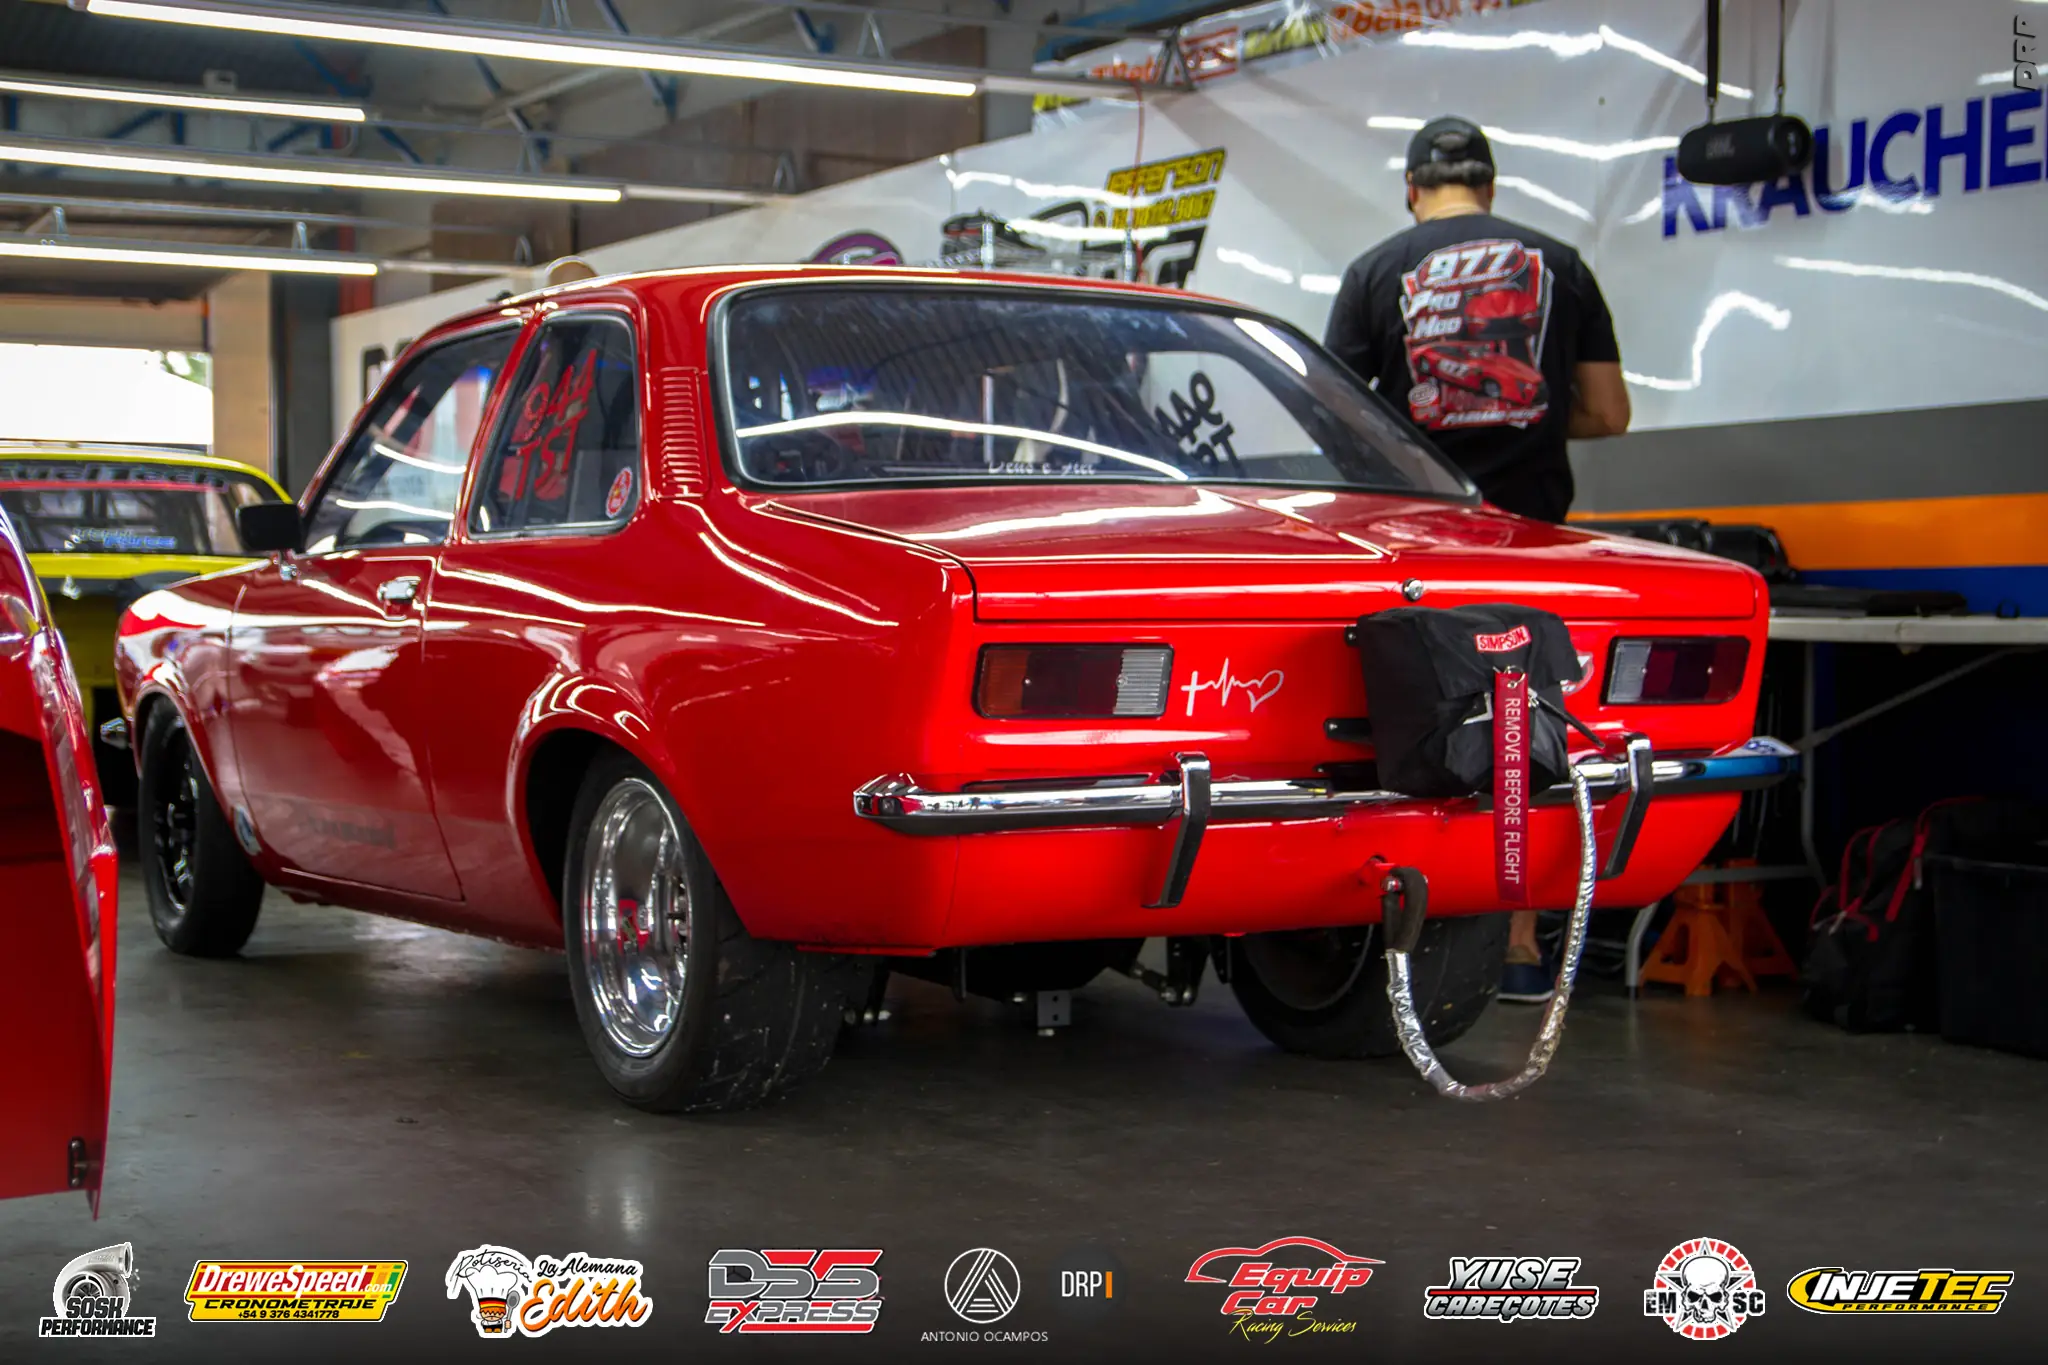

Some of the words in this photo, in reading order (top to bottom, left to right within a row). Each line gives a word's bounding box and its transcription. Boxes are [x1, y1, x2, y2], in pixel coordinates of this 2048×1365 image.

[1423, 243, 1517, 286] 977
[525, 350, 597, 441] 944
[516, 406, 589, 500] TST
[1480, 628, 1527, 649] SIMPSON
[1504, 698, 1521, 762] REMOVE
[1504, 769, 1521, 825] BEFORE
[1504, 832, 1521, 884] FLIGHT
